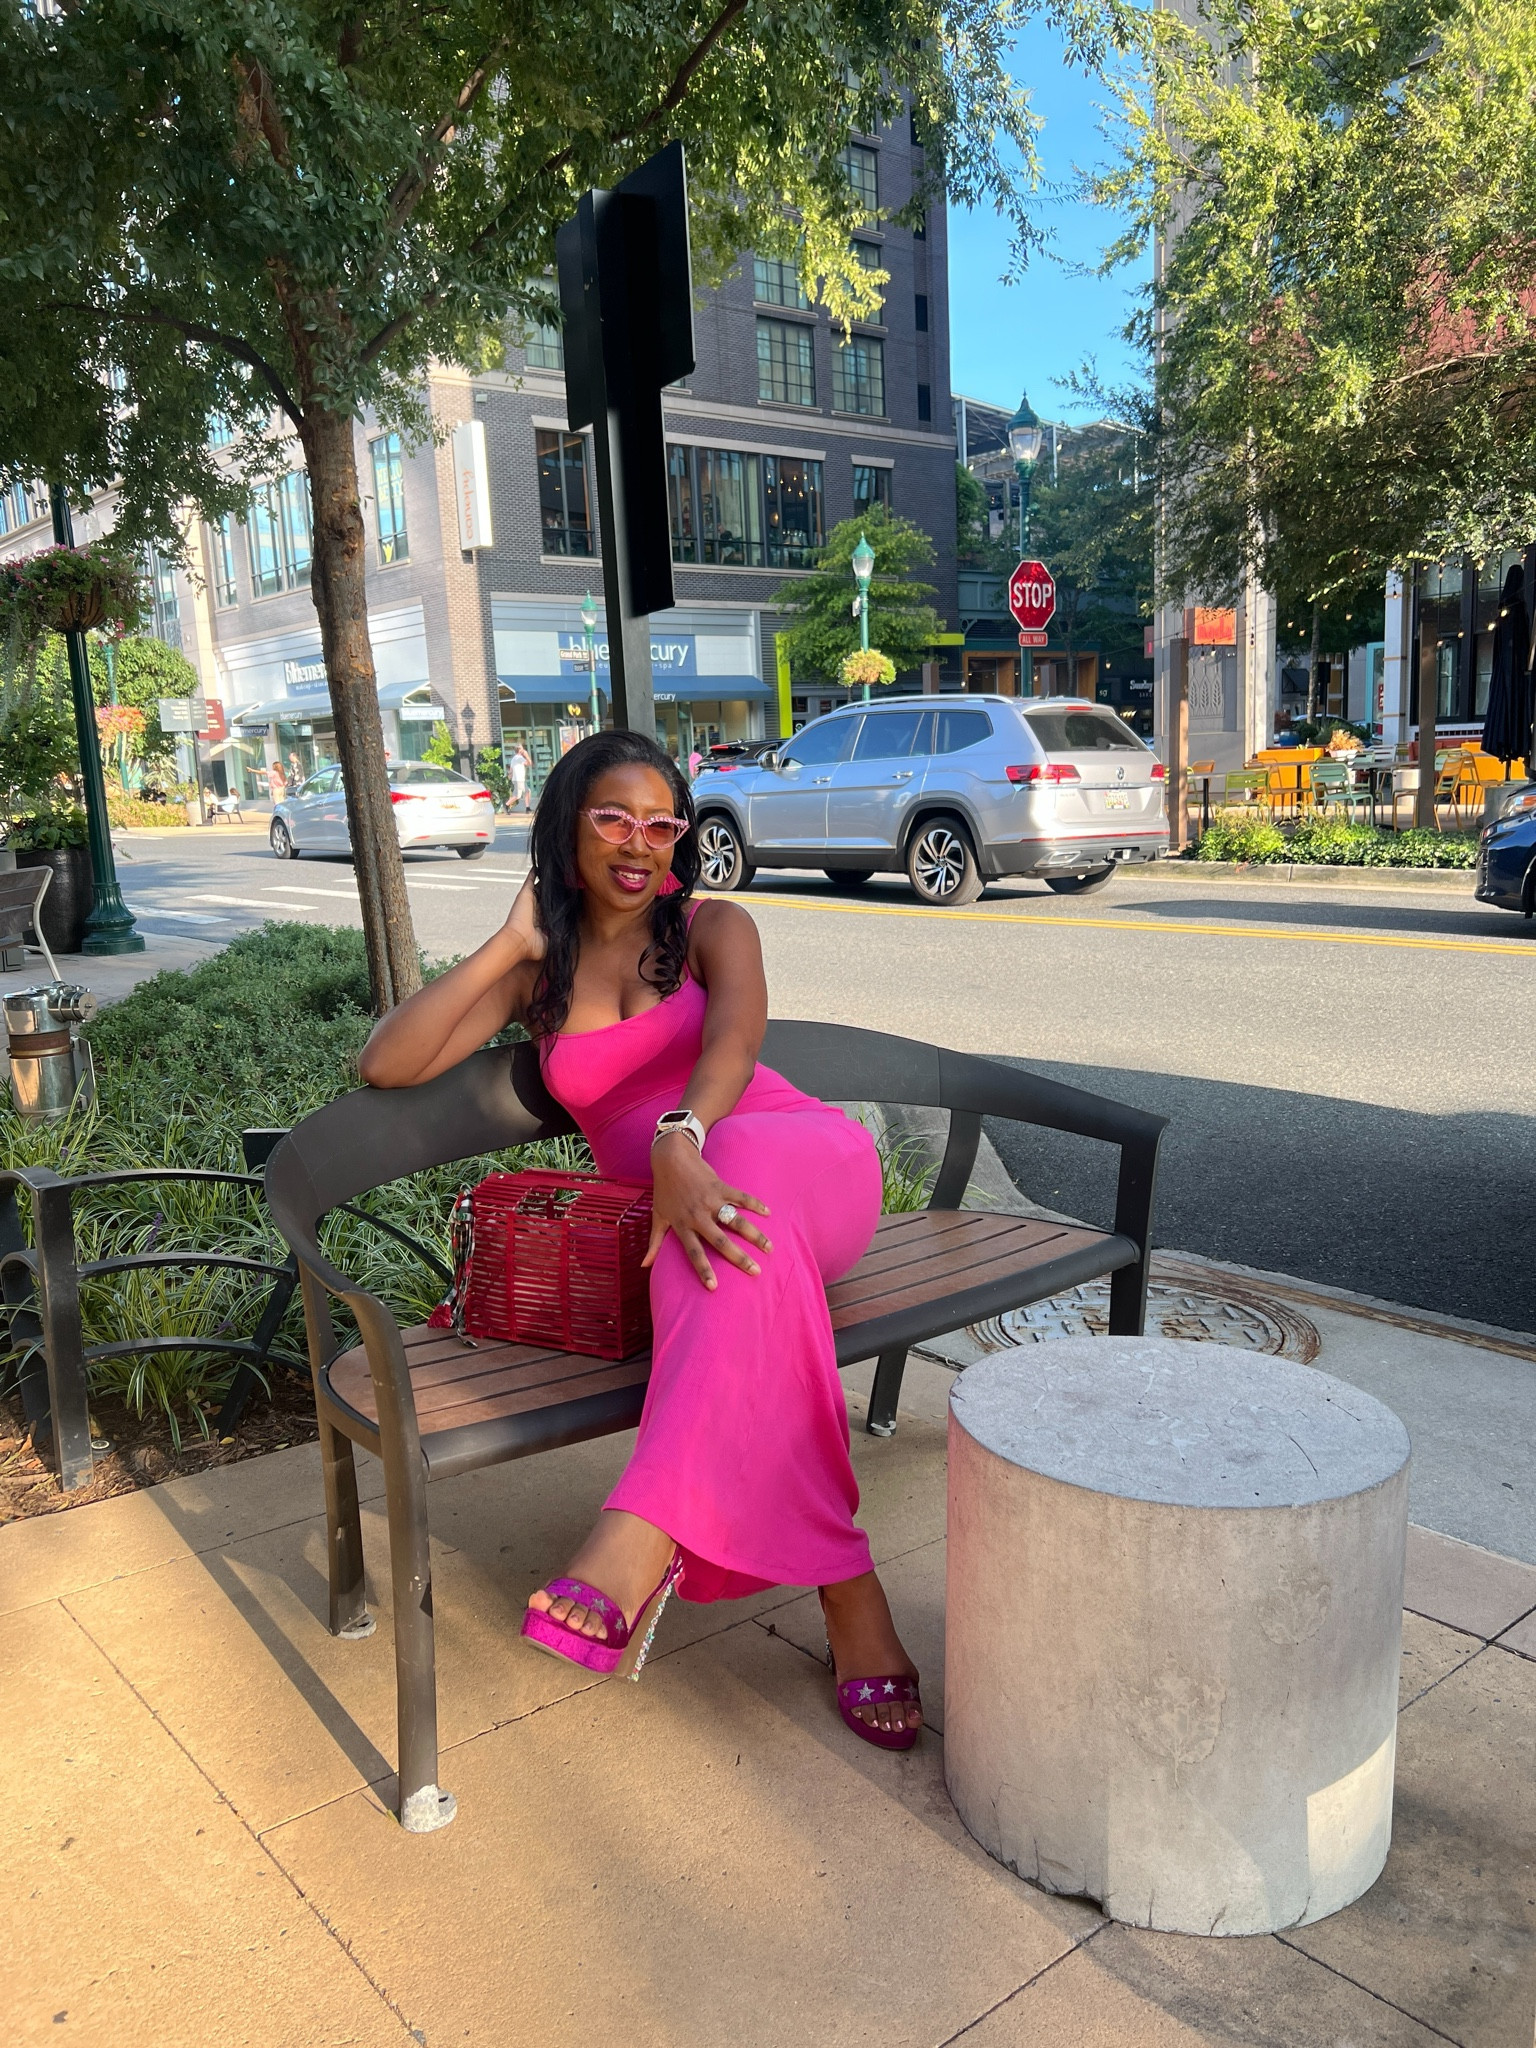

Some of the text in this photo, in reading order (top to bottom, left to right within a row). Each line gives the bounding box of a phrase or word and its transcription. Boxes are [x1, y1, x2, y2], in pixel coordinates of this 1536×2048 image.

[463, 469, 474, 540] canopy
[1013, 582, 1052, 608] STOP
[1022, 635, 1045, 643] ALL WAY
[659, 663, 672, 671] spa
[653, 692, 676, 702] ercury
